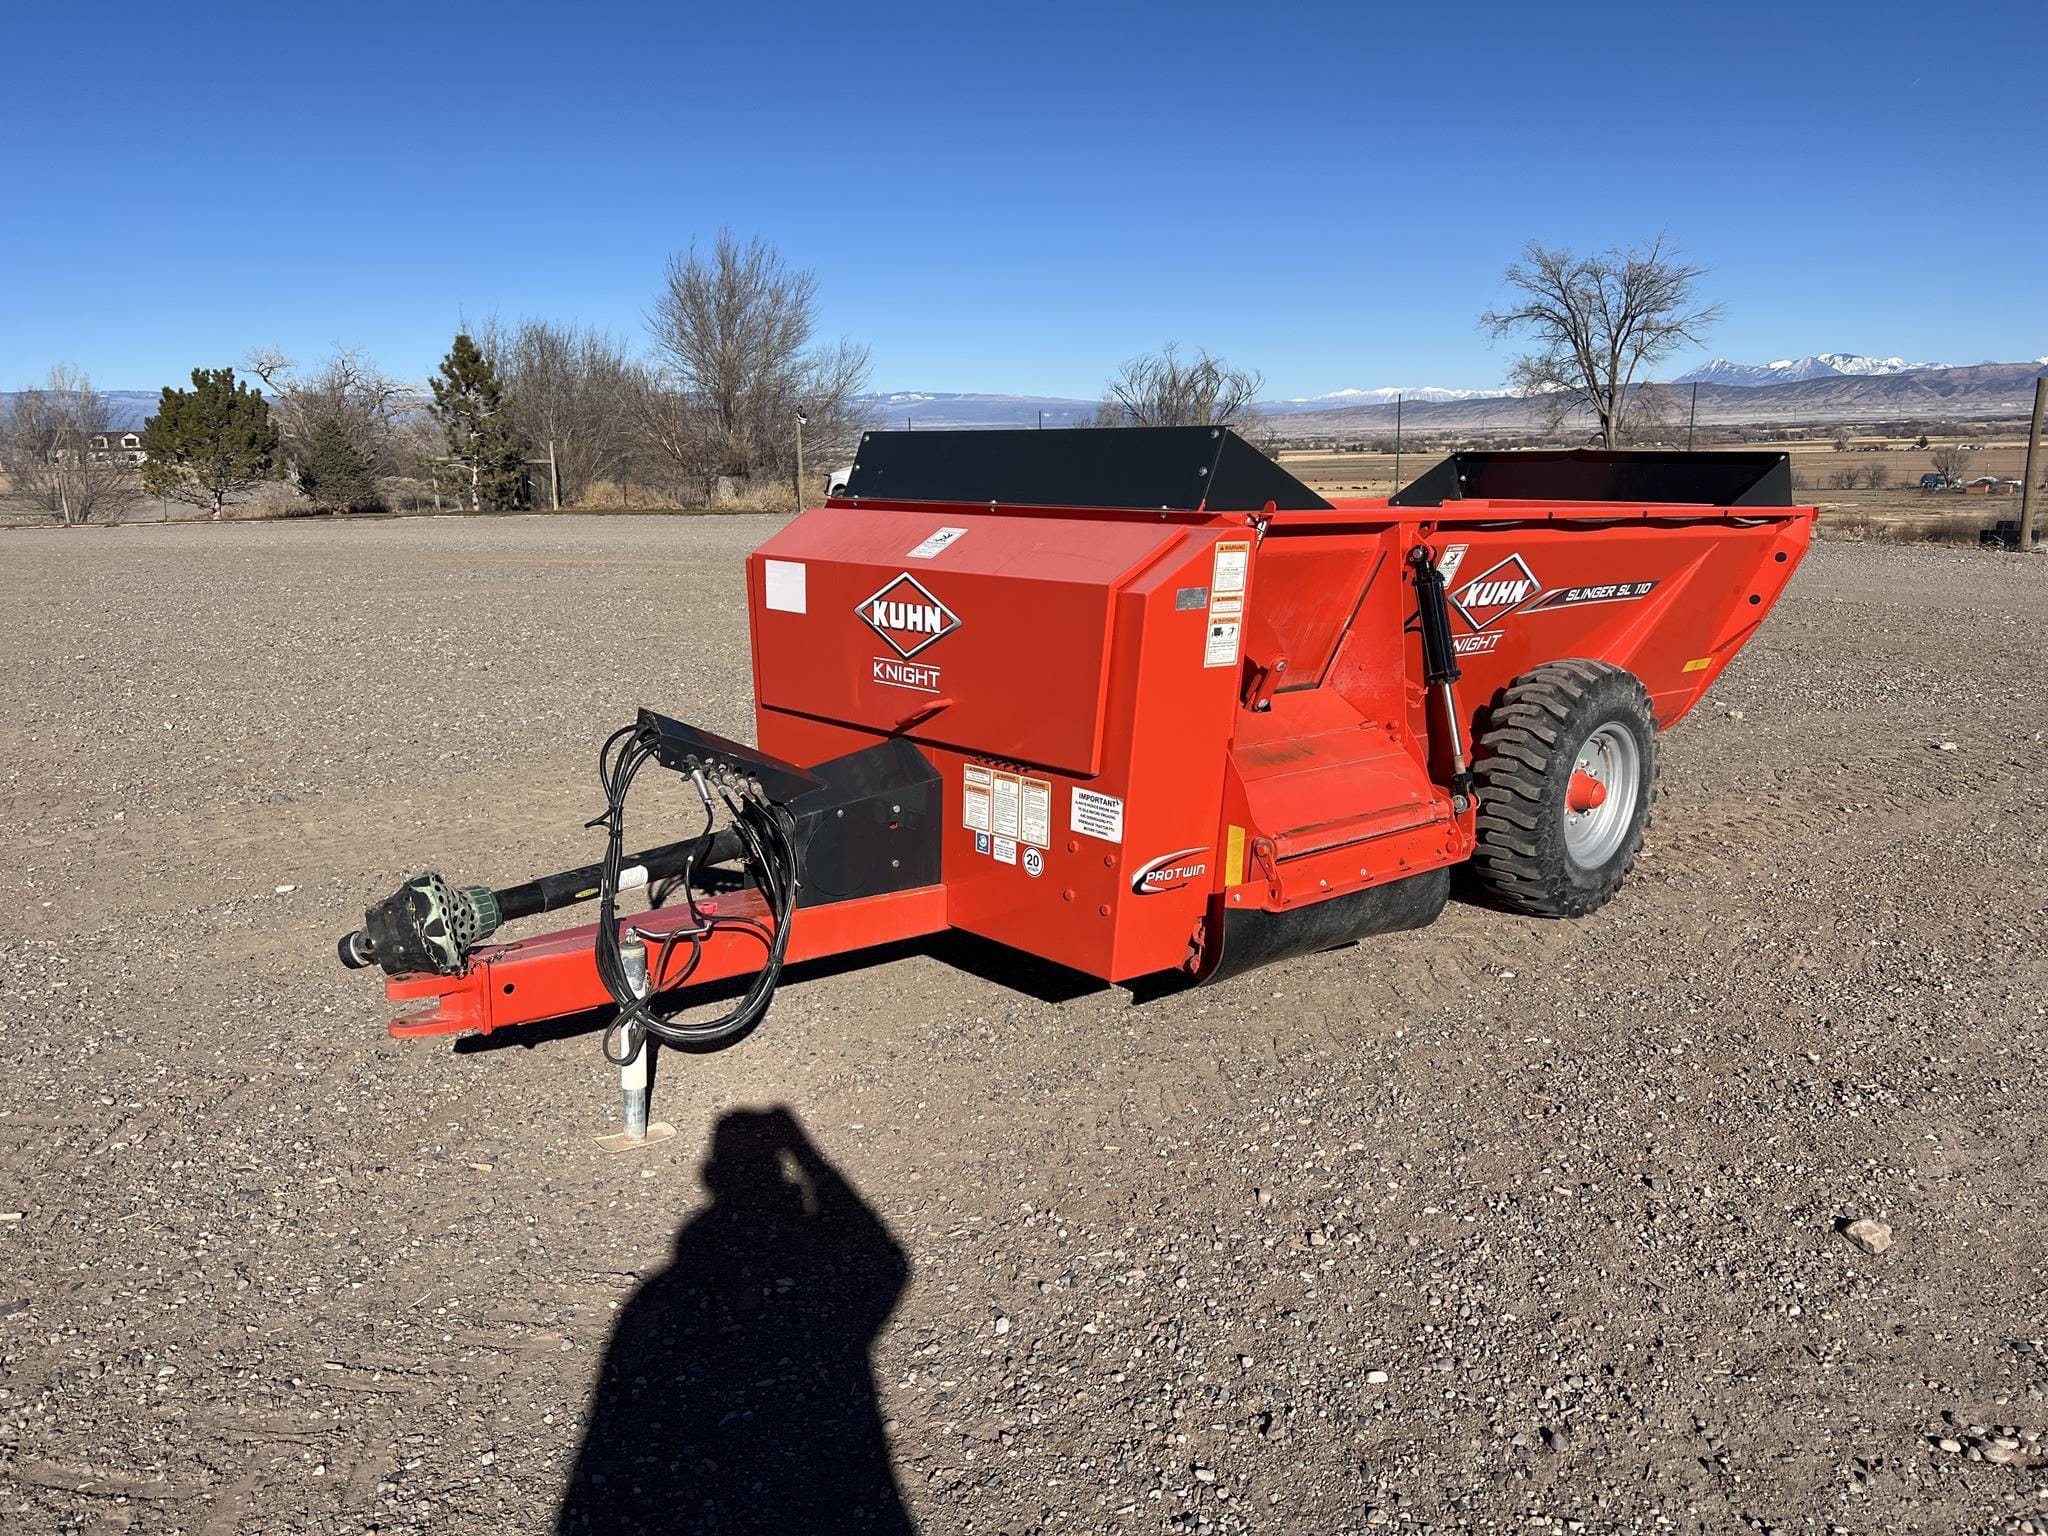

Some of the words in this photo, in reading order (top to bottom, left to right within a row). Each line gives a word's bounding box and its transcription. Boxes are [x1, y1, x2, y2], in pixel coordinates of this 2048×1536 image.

[1461, 580, 1531, 608] KUHN
[1565, 585, 1617, 602] SLINGER
[1616, 584, 1632, 596] SL
[1634, 582, 1652, 595] 110
[873, 600, 941, 634] KUHN
[1453, 634, 1503, 652] NIGHT
[873, 661, 940, 687] KNIGHT
[1078, 792, 1116, 808] IMPORTANT
[1026, 853, 1040, 867] 20
[1145, 864, 1206, 883] PROTWIN
